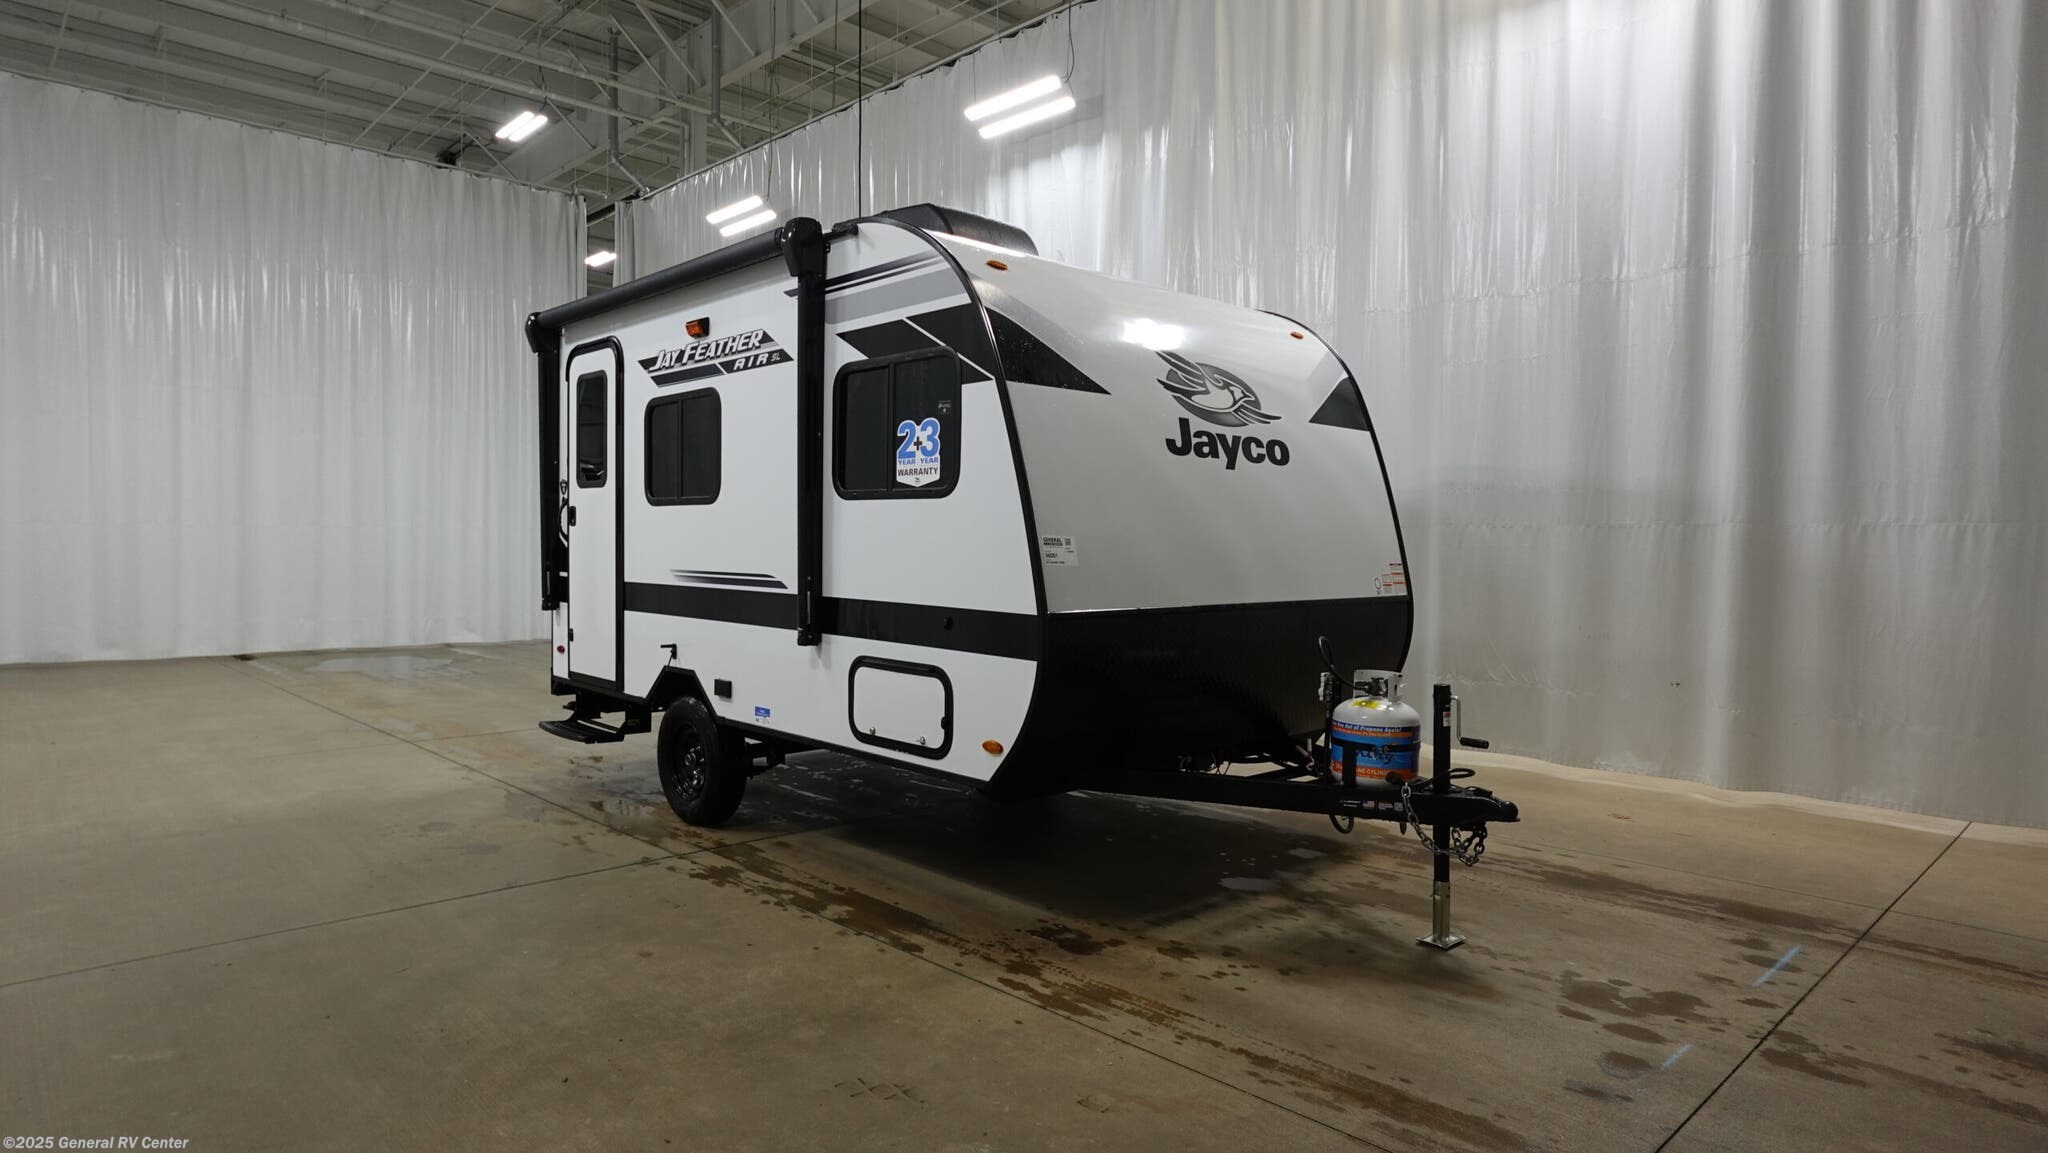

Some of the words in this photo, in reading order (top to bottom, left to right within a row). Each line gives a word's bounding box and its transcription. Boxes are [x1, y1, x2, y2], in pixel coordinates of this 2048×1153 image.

[649, 350, 681, 371] JAY
[682, 329, 764, 364] FEATHER
[733, 352, 769, 371] AIR
[1165, 417, 1291, 471] Jayco
[898, 458, 917, 466] YEAR
[920, 456, 939, 465] YEAR
[897, 466, 939, 477] WARRANTY
